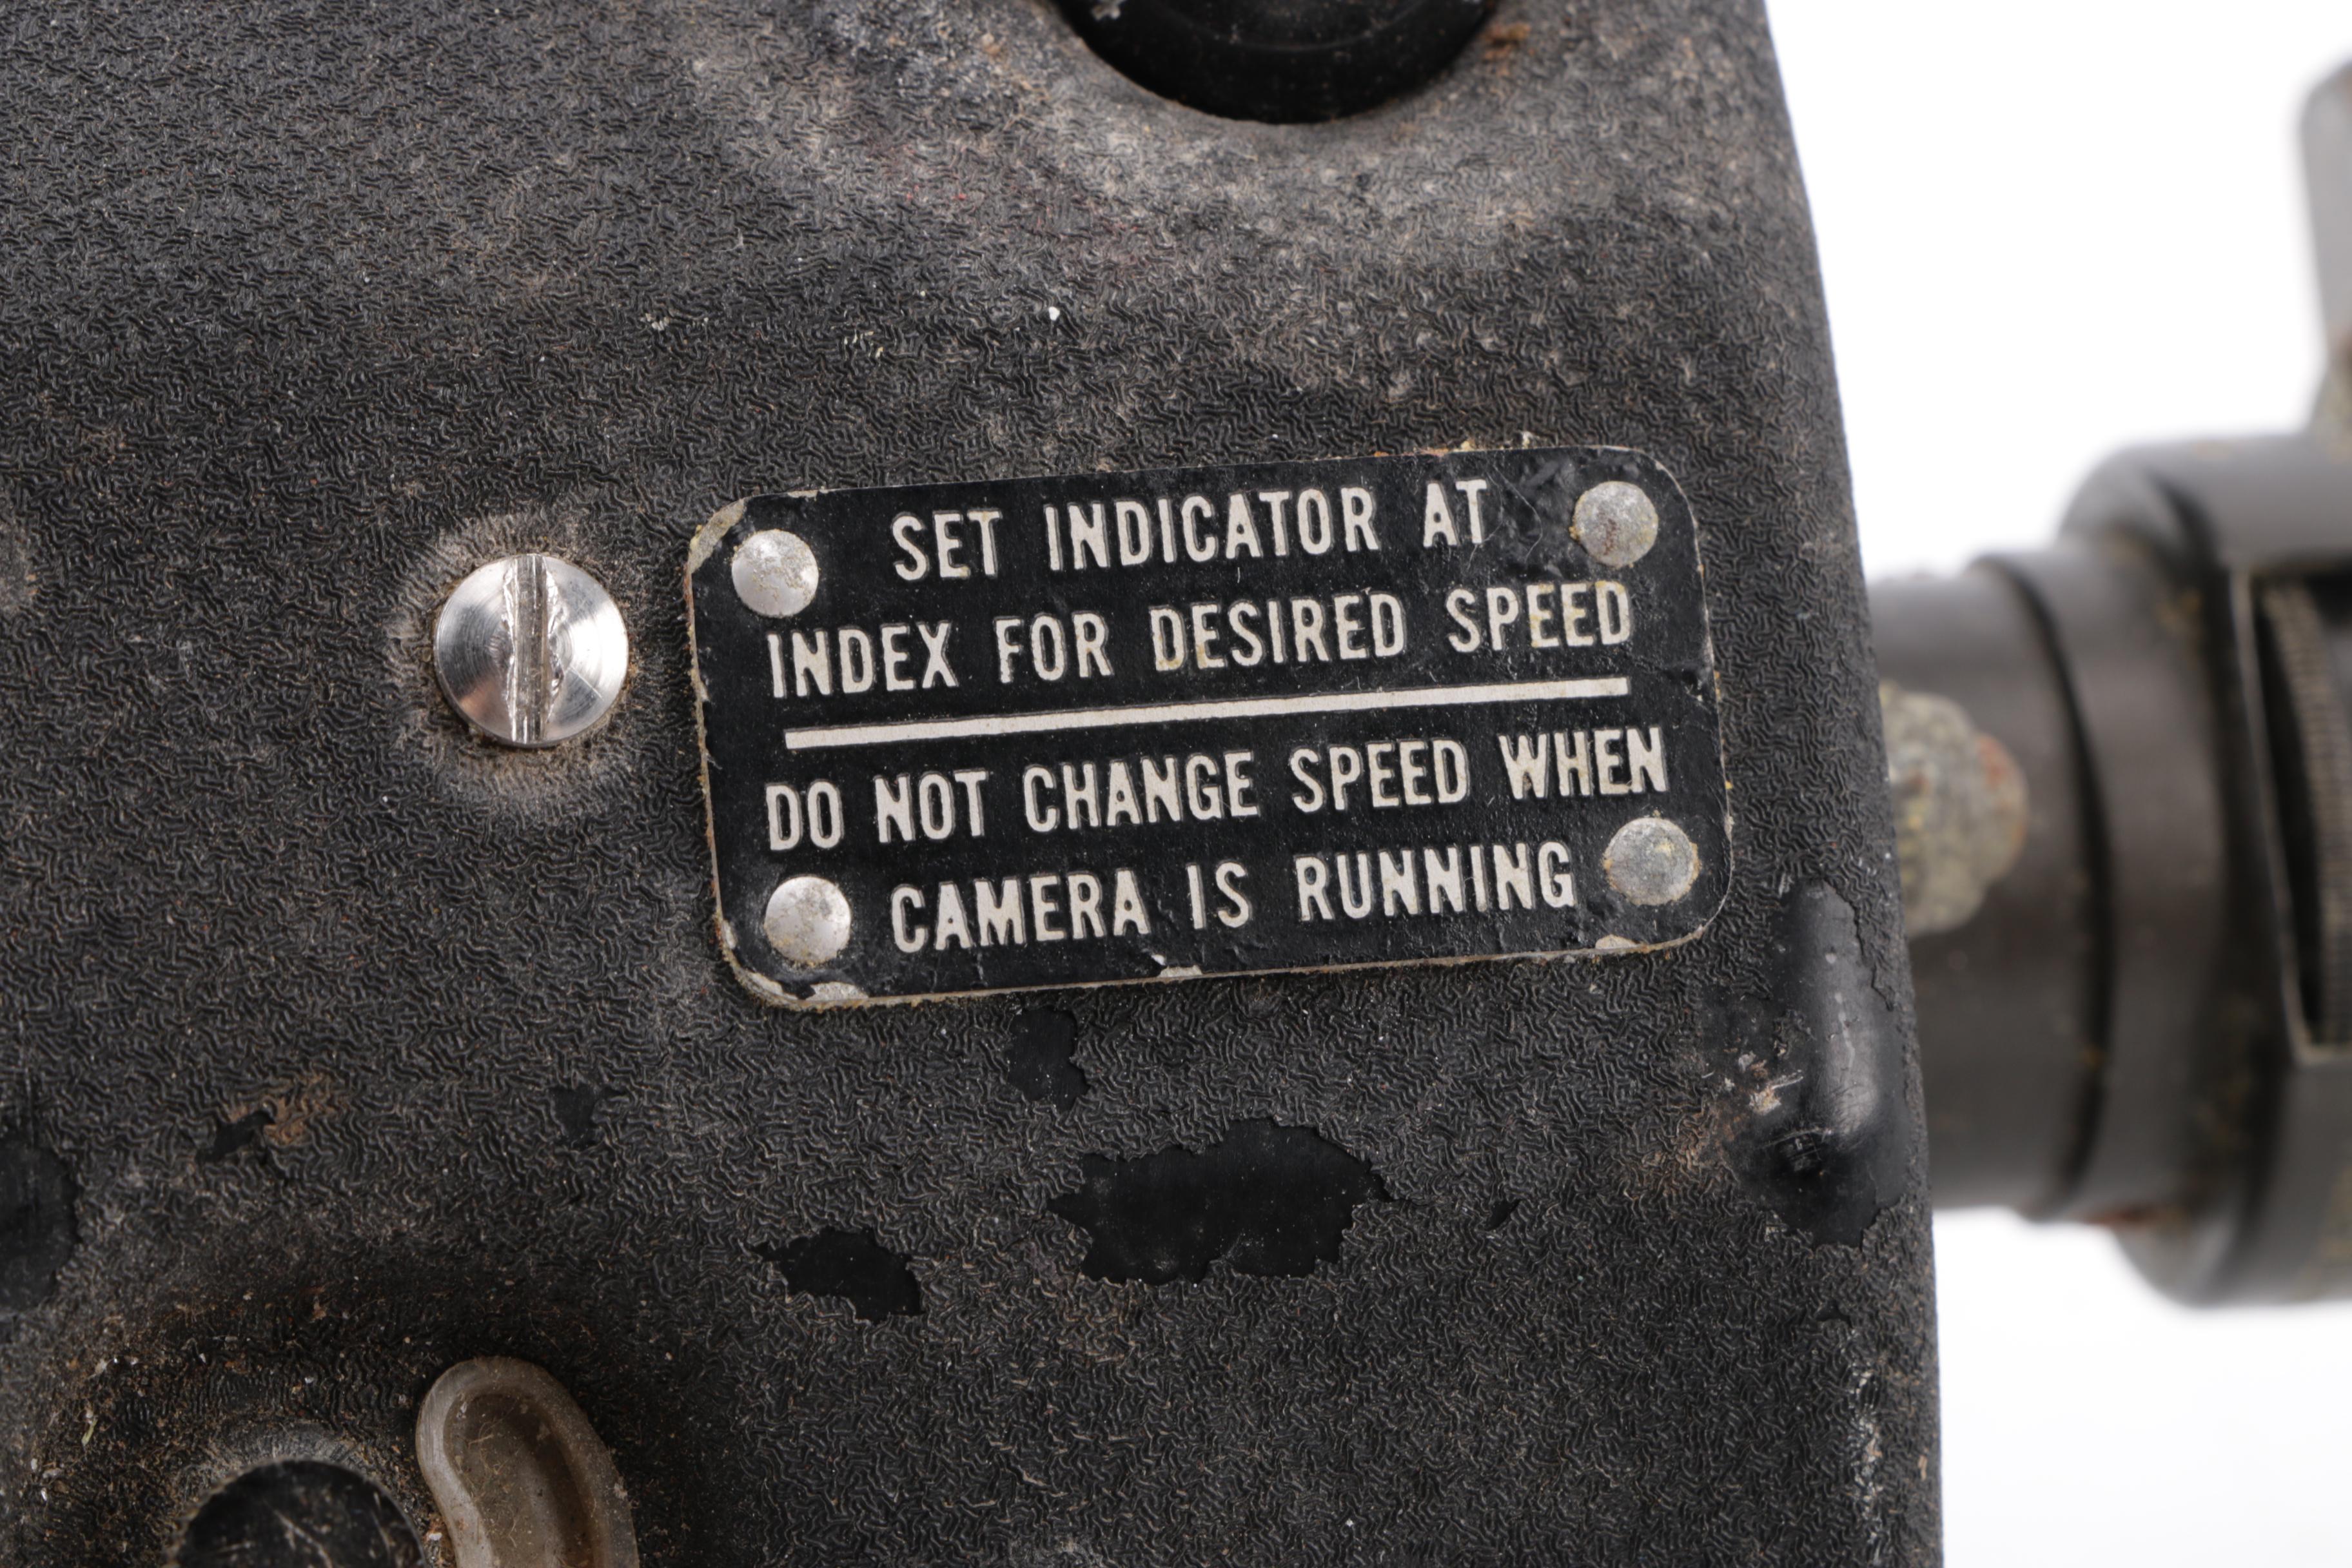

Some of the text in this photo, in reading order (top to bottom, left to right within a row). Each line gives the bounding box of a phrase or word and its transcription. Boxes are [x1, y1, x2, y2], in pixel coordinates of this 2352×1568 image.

[891, 478, 1489, 581] SET INDICATOR AT
[767, 578, 1634, 698] INDEX FOR DESIRED SPEED
[765, 727, 1669, 851] DO NOT CHANGE SPEED WHEN
[890, 841, 1582, 954] CAMERA IS RUNNING
